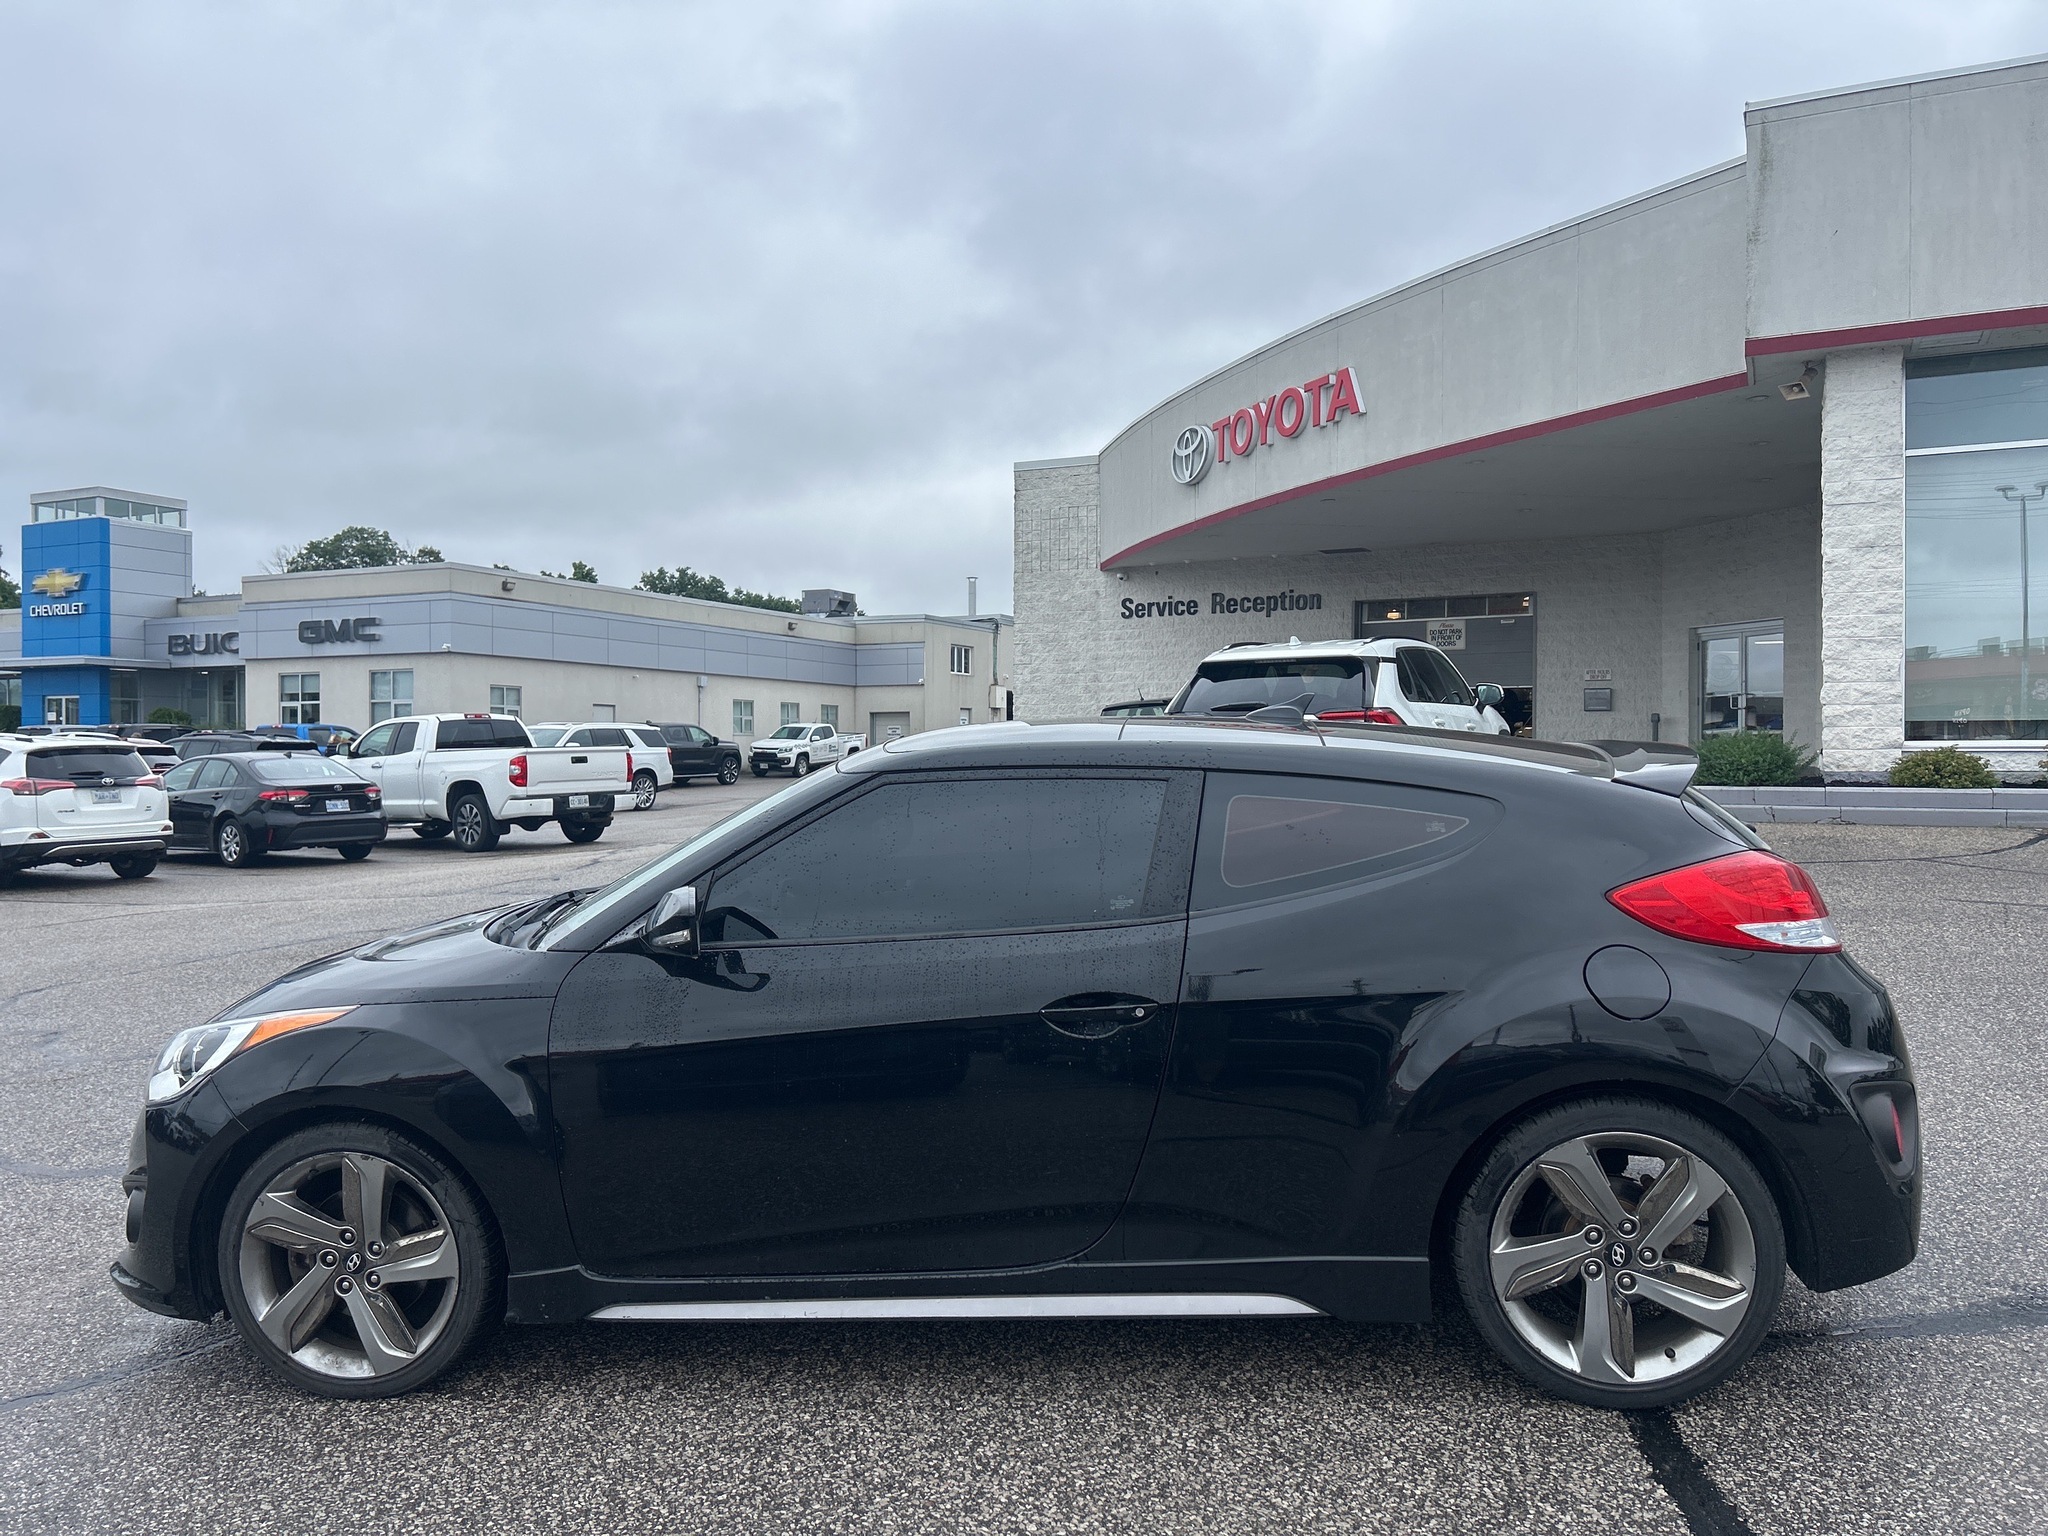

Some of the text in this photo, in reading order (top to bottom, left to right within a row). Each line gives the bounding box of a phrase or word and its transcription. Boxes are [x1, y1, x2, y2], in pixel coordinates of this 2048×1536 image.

[1212, 366, 1365, 463] TOYOTA
[29, 602, 84, 617] CHEVROLET
[1120, 589, 1322, 620] Service Reception
[167, 631, 239, 656] BUIC
[298, 617, 381, 644] GMC
